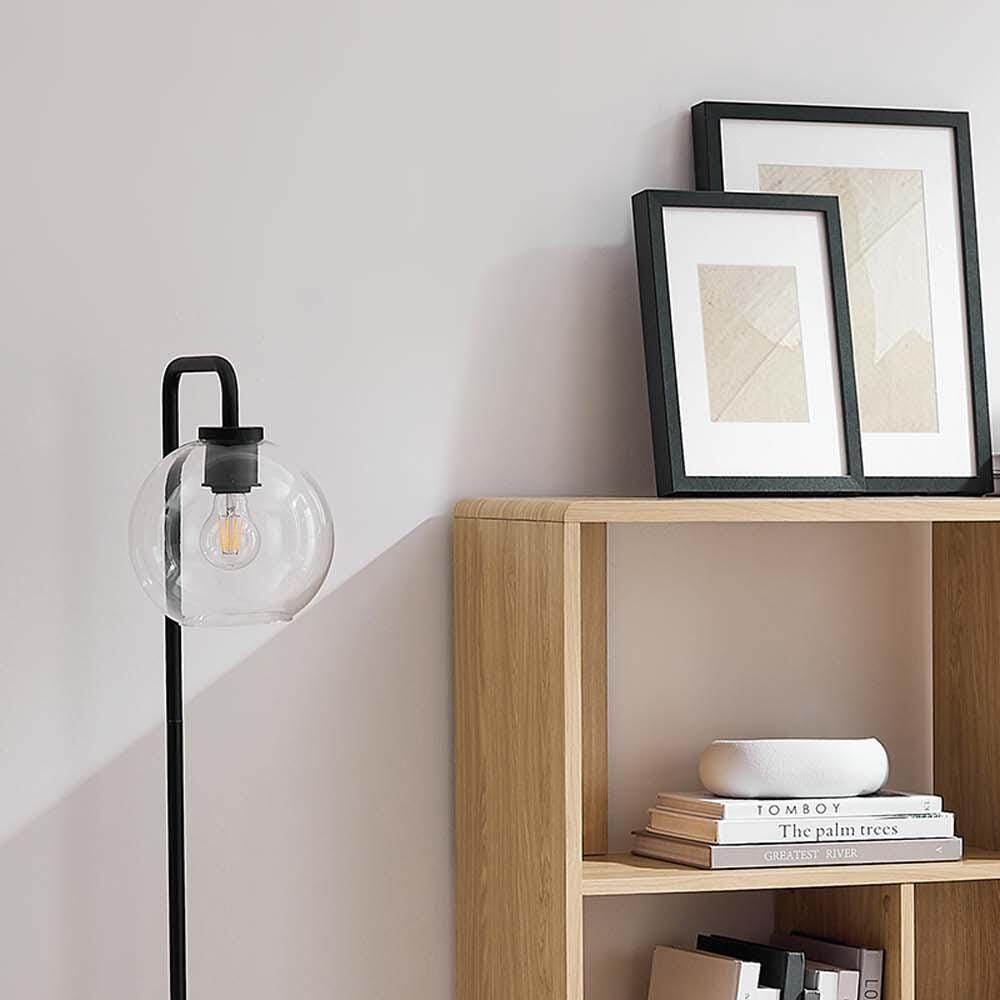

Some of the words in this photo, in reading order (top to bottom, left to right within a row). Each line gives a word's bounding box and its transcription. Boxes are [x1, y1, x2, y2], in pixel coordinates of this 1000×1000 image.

[757, 803, 841, 816] TOMBOY
[778, 822, 811, 839] The
[816, 822, 855, 842] palm
[860, 822, 899, 837] trees
[764, 849, 819, 862] GREATEST
[826, 848, 858, 860] RIVER
